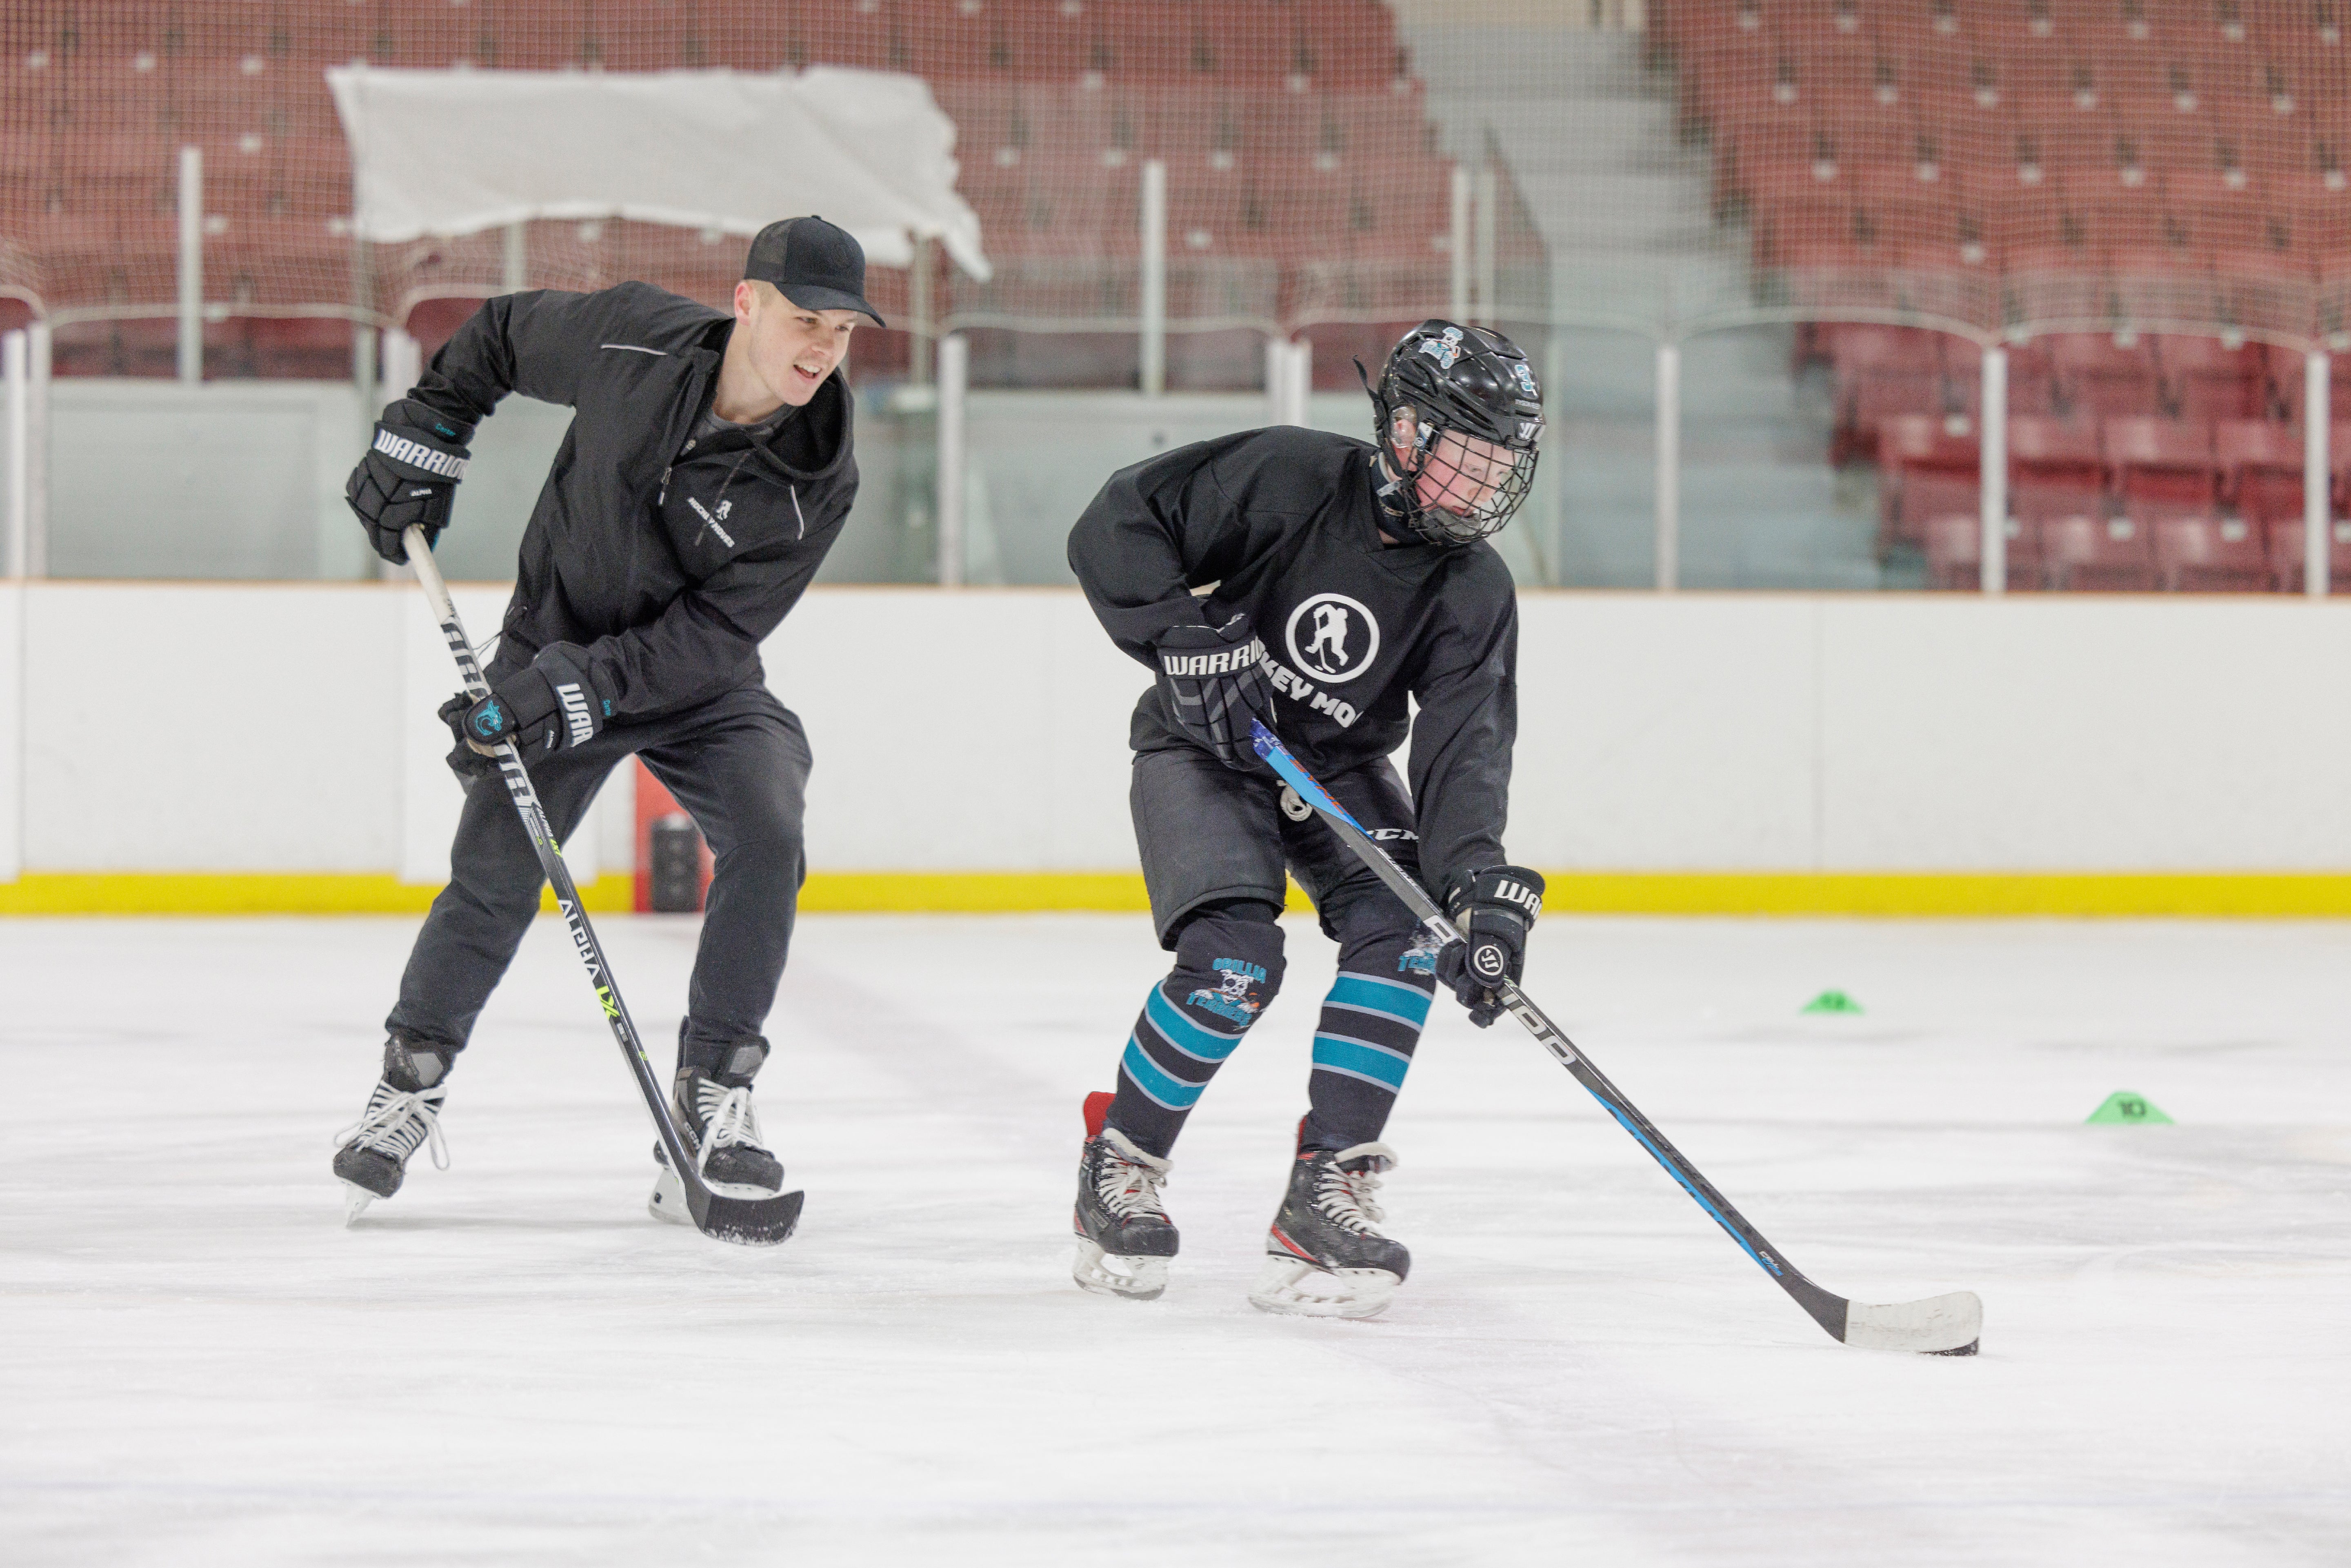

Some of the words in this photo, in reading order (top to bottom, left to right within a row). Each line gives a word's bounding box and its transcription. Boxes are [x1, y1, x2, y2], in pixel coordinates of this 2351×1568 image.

[410, 488, 432, 497] ALPHA
[711, 522, 735, 548] MOVES
[1309, 691, 1364, 728] MO
[536, 805, 553, 837] ALPHA
[558, 899, 601, 982] ALPHA
[1212, 957, 1267, 984] ORILLIA
[1186, 992, 1253, 1027] TERRIERS
